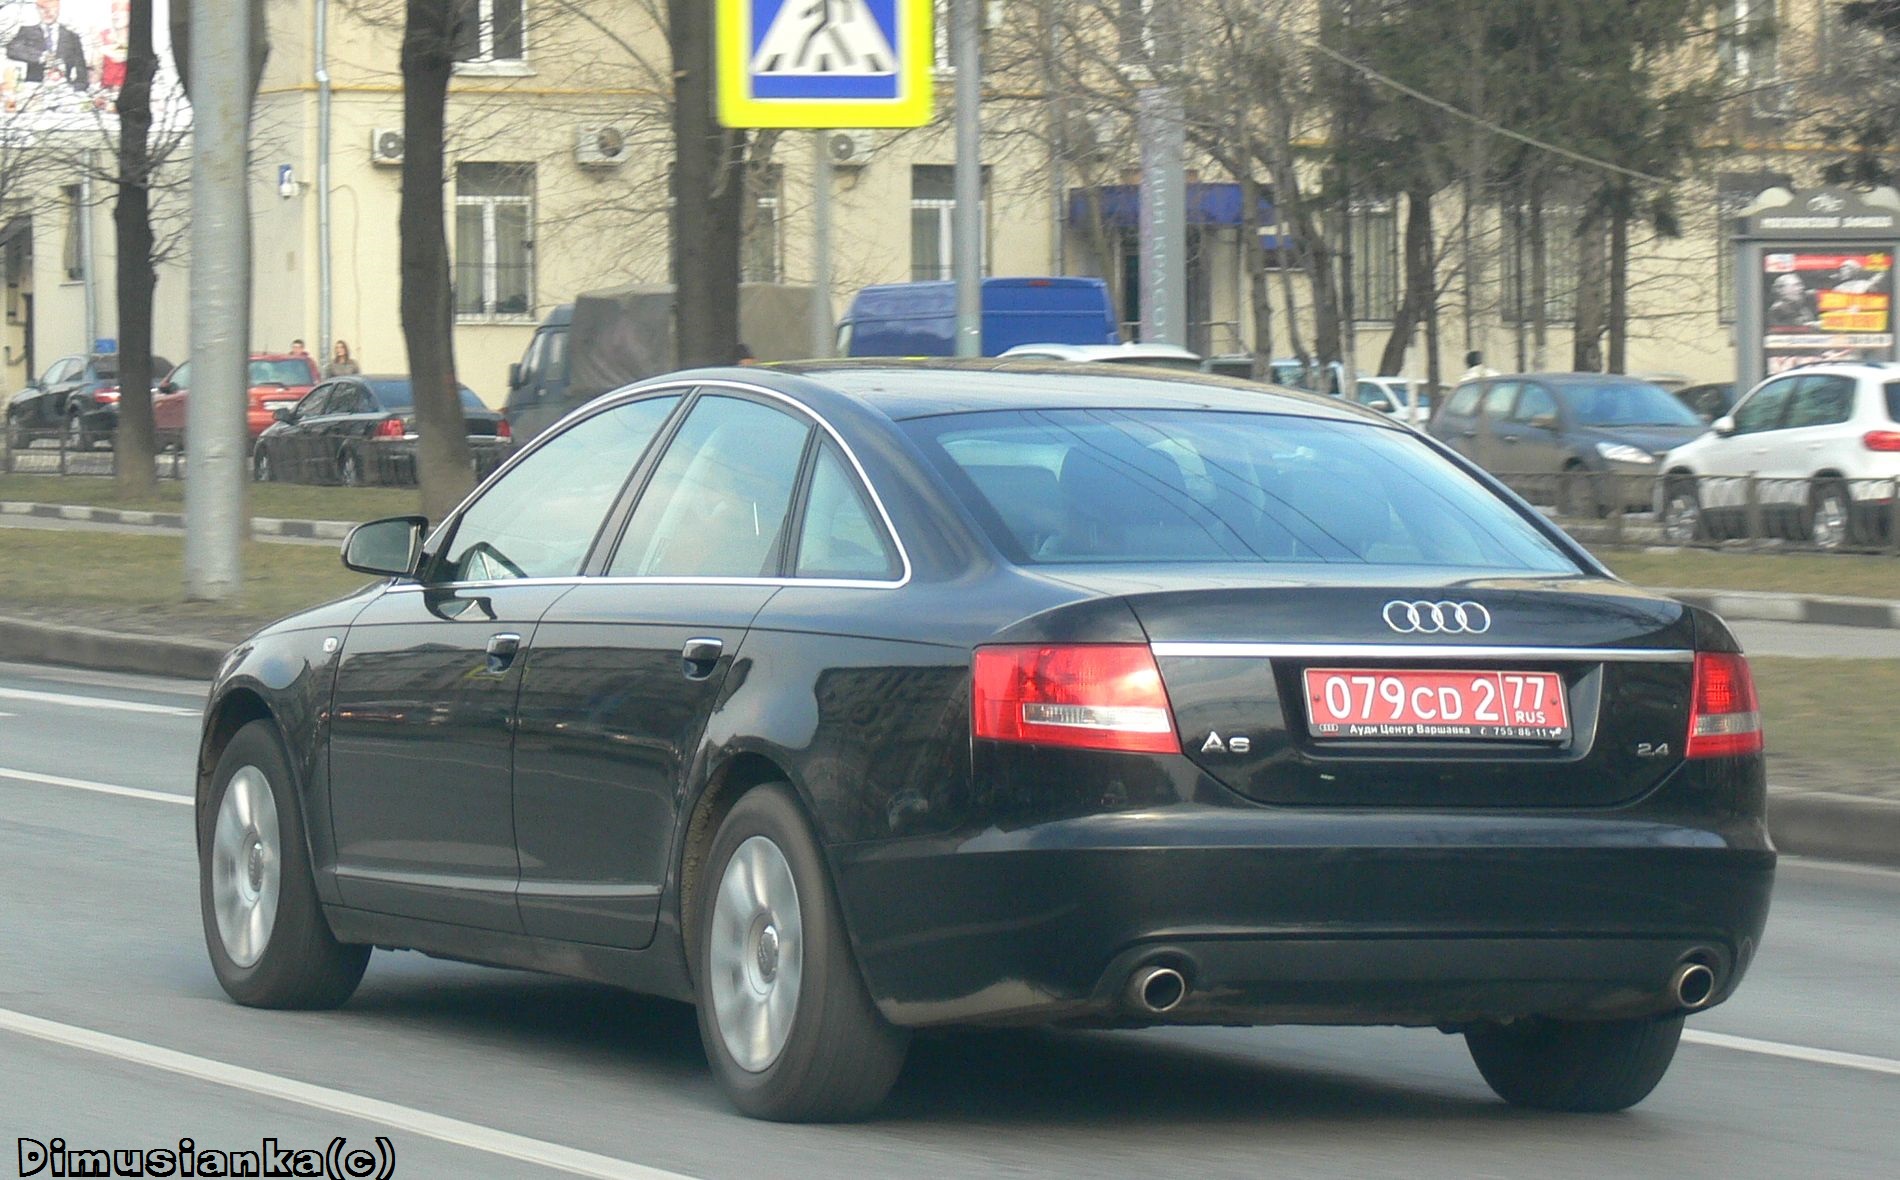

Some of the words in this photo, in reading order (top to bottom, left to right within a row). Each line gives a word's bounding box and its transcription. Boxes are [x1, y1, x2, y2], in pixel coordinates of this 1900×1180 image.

[1505, 676, 1545, 710] 77
[1515, 710, 1546, 724] RUS
[1349, 724, 1378, 736] Ауди
[1380, 724, 1414, 736] Центр
[1416, 724, 1471, 736] Варшавка
